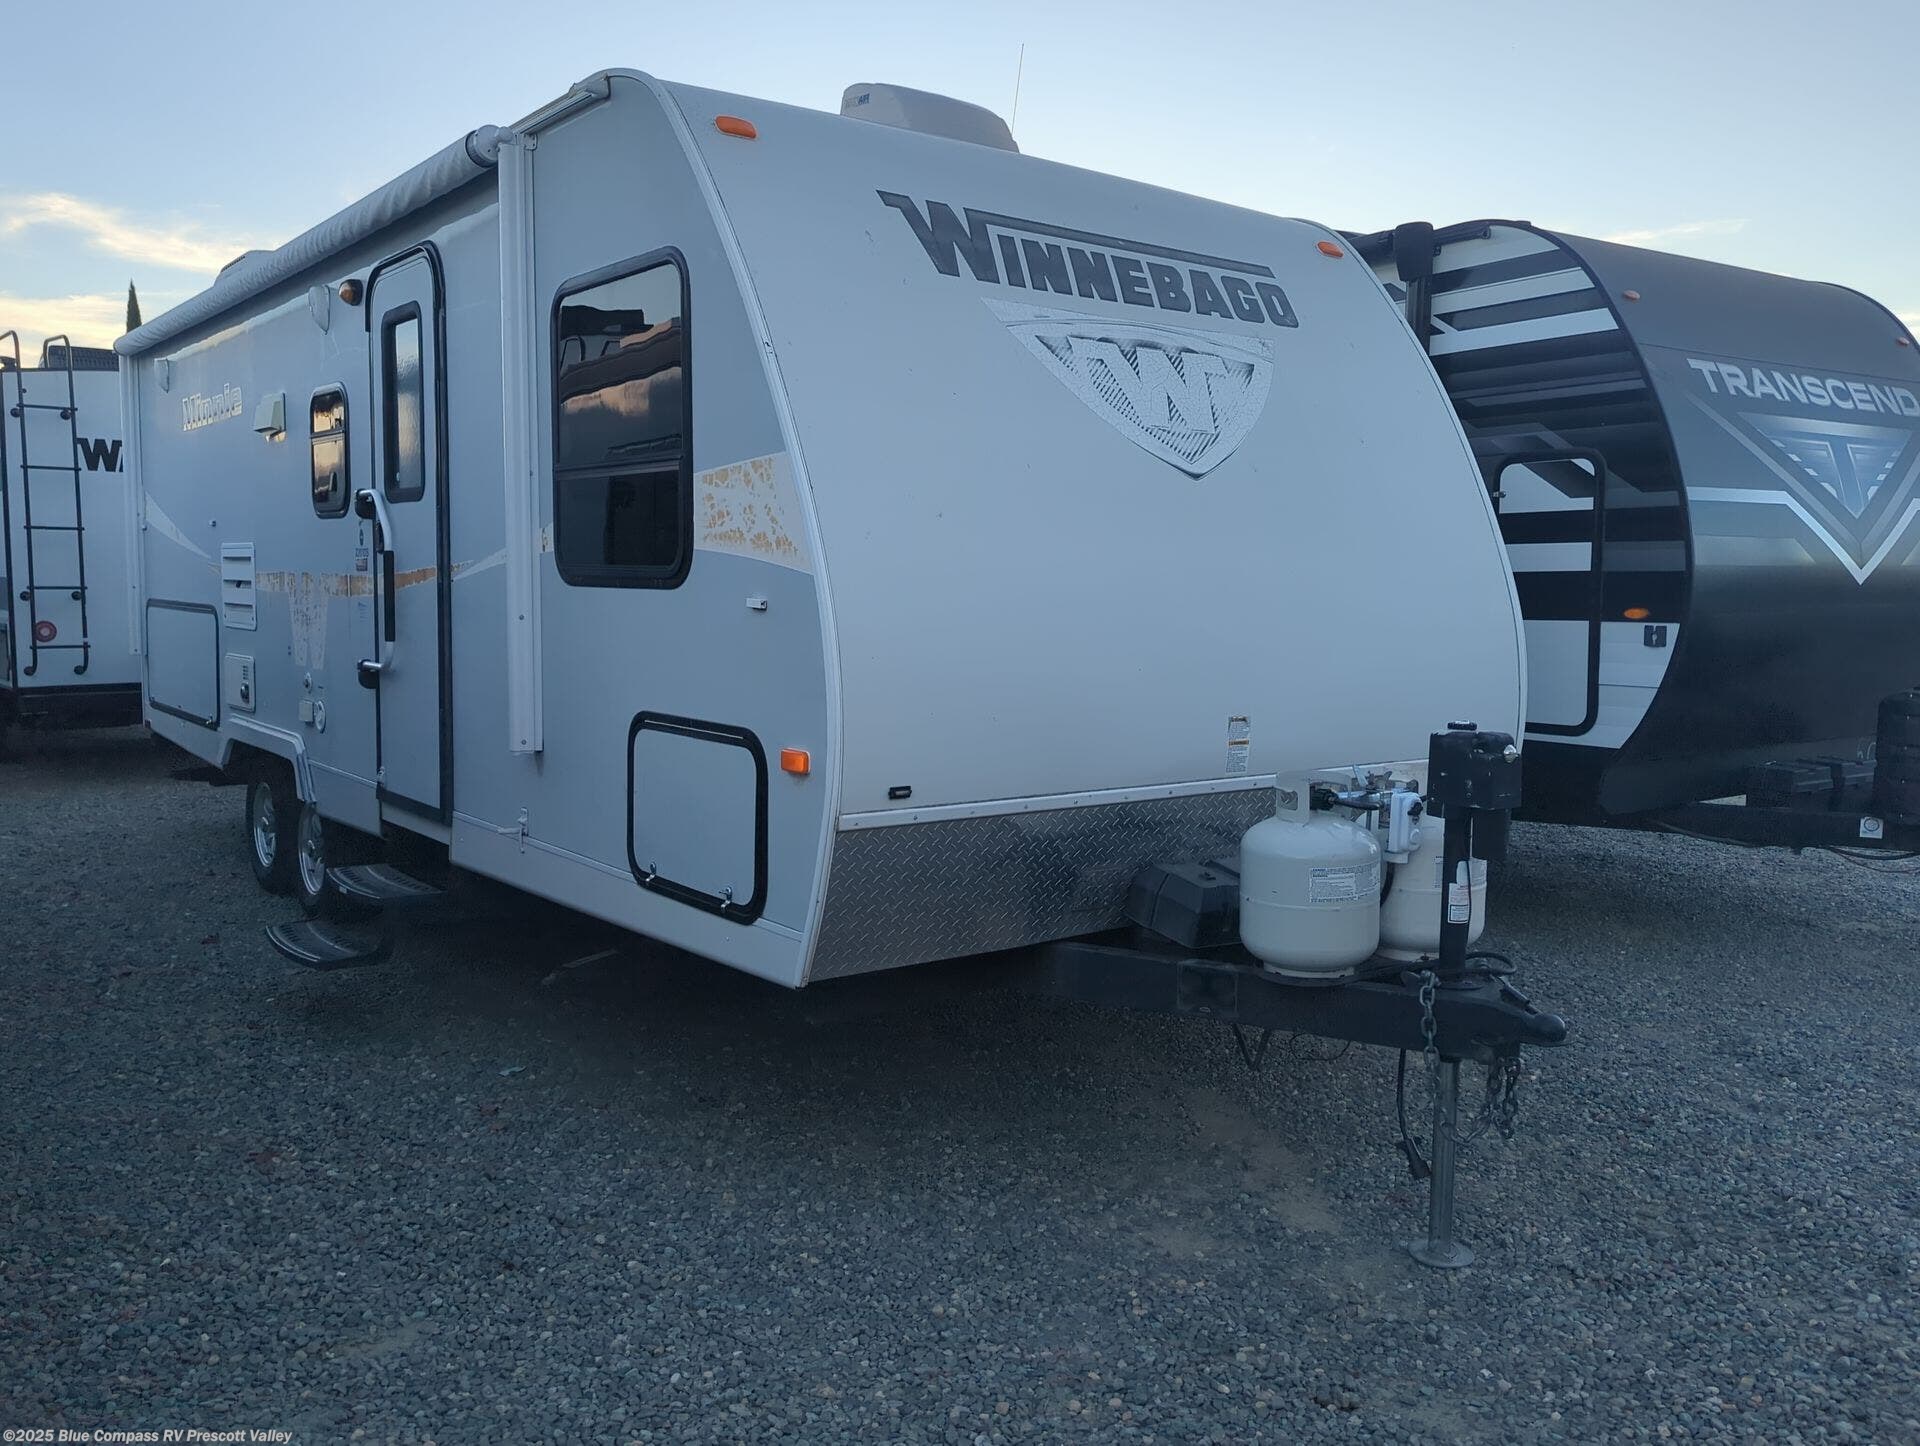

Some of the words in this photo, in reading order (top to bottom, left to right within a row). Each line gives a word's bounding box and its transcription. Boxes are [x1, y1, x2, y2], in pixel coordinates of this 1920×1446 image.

[876, 189, 1299, 329] WINNEBAGO
[182, 383, 242, 431] Minnie
[1686, 358, 1920, 417] TRANSCEND
[76, 437, 123, 472] W
